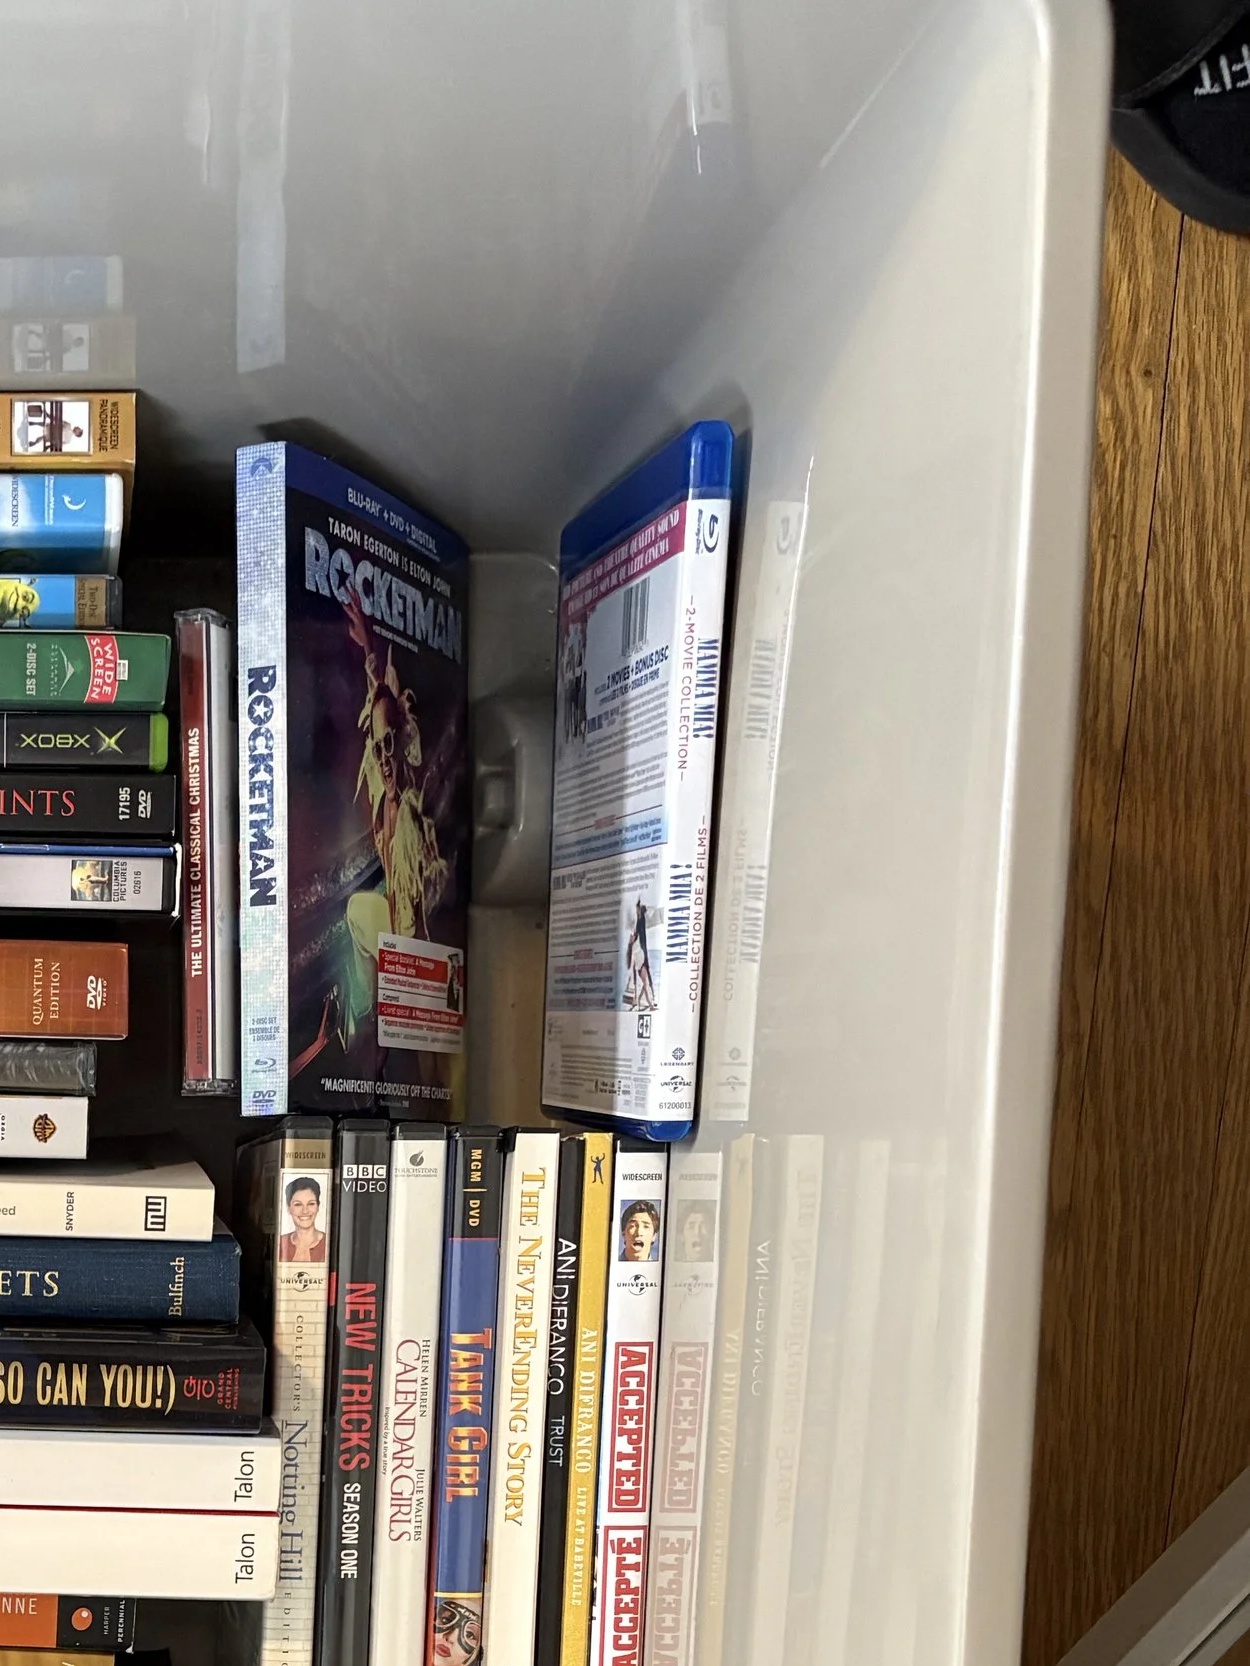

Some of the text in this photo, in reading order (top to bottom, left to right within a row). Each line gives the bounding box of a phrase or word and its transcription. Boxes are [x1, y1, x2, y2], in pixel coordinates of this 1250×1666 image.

[304, 526, 463, 665] ROCKETMAN
[89, 637, 102, 700] SCREEN
[102, 643, 116, 696] WIDE
[20, 732, 91, 749] XBOX
[118, 786, 131, 821] 17195
[247, 665, 277, 908] ROCKETMAN
[188, 727, 203, 978] THE ULTIMATE CLASSICAL CHRISTMAS
[342, 1180, 387, 1193] VIDEO
[343, 1165, 387, 1179] BBC
[518, 1167, 548, 1227] THE
[168, 1256, 185, 1317] Bulfinch
[36, 1361, 88, 1406] CAN
[100, 1364, 176, 1416] YOU!)
[418, 1339, 430, 1418] HELEN MIRREN
[547, 1238, 578, 1468] ANI DIFRANCO TRUST
[338, 1282, 378, 1580] NEW TRICKS SEASON ONE
[387, 1339, 422, 1543] CALENDAR GIRLS
[444, 1326, 492, 1503] TANK GIRL
[613, 1348, 648, 1507] ACCEPTED
[234, 1450, 255, 1503] Talon
[279, 1419, 309, 1583] Notting Hill
[503, 1440, 532, 1527] STORY
